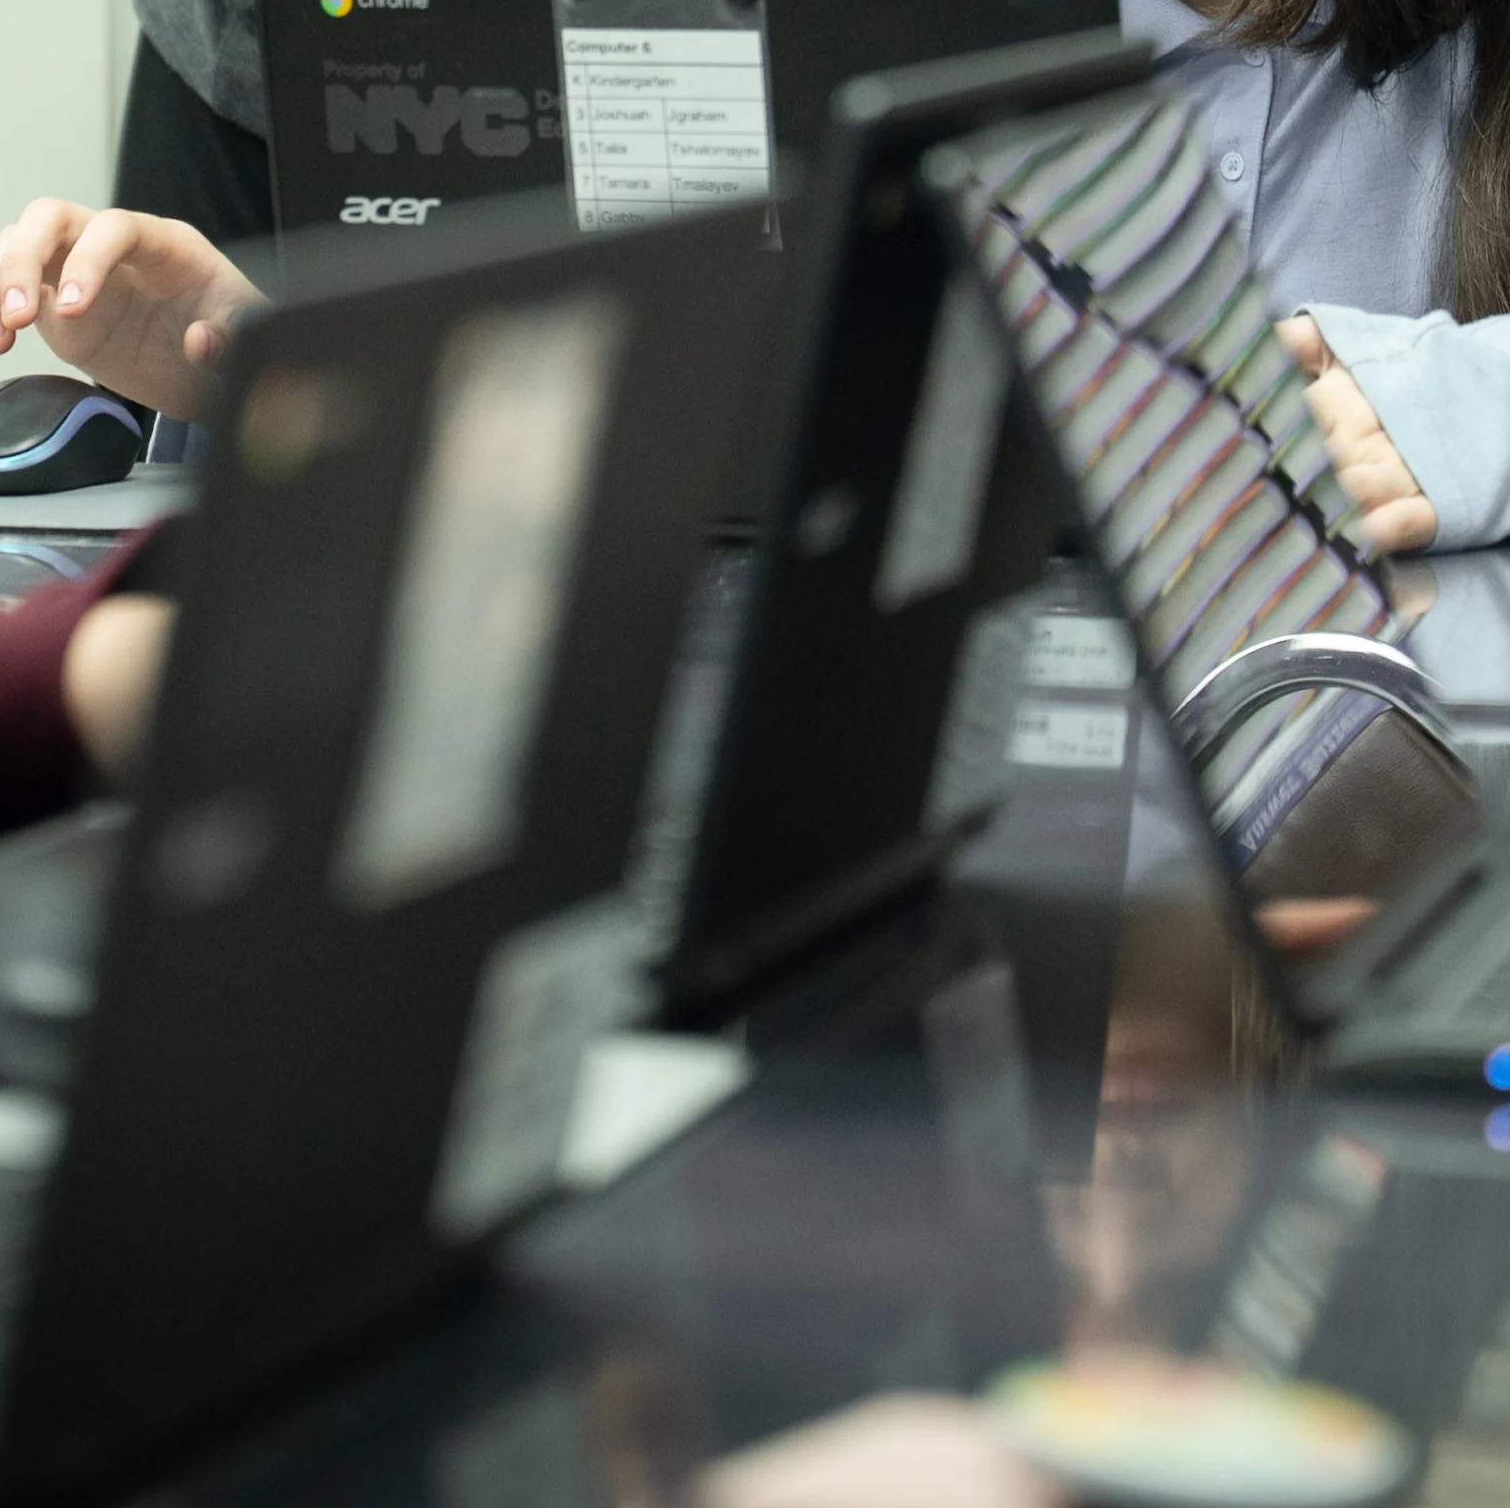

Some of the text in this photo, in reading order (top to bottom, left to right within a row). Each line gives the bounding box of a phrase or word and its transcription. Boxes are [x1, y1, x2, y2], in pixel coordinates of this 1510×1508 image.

[565, 40, 637, 55] Computer
[322, 59, 426, 83] Property of
[324, 84, 531, 157] NYC
[340, 196, 441, 225] acer
